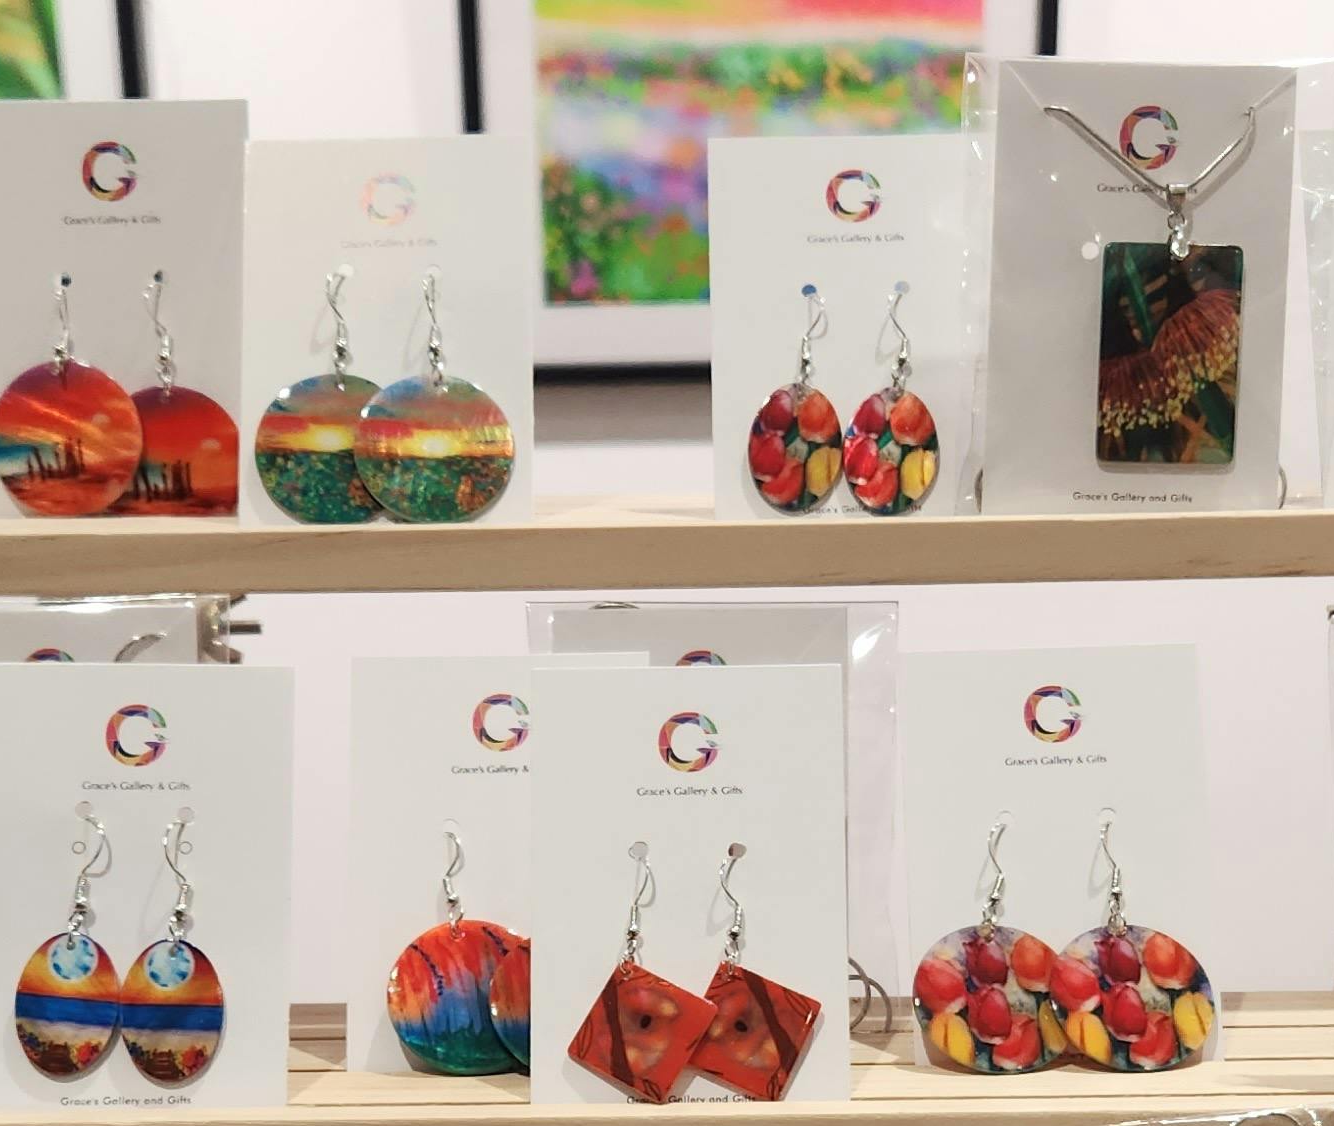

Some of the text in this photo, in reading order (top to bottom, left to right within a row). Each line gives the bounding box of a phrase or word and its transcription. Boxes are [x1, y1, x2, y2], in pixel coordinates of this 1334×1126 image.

[1072, 492, 1192, 503] Grace's Gallery and Gifts
[1005, 755, 1107, 766] Grace's Gallery & Gifts
[636, 785, 743, 798] Grace's Gallery & Gifts
[60, 1095, 192, 1107] Grace's Gallery and Gifts
